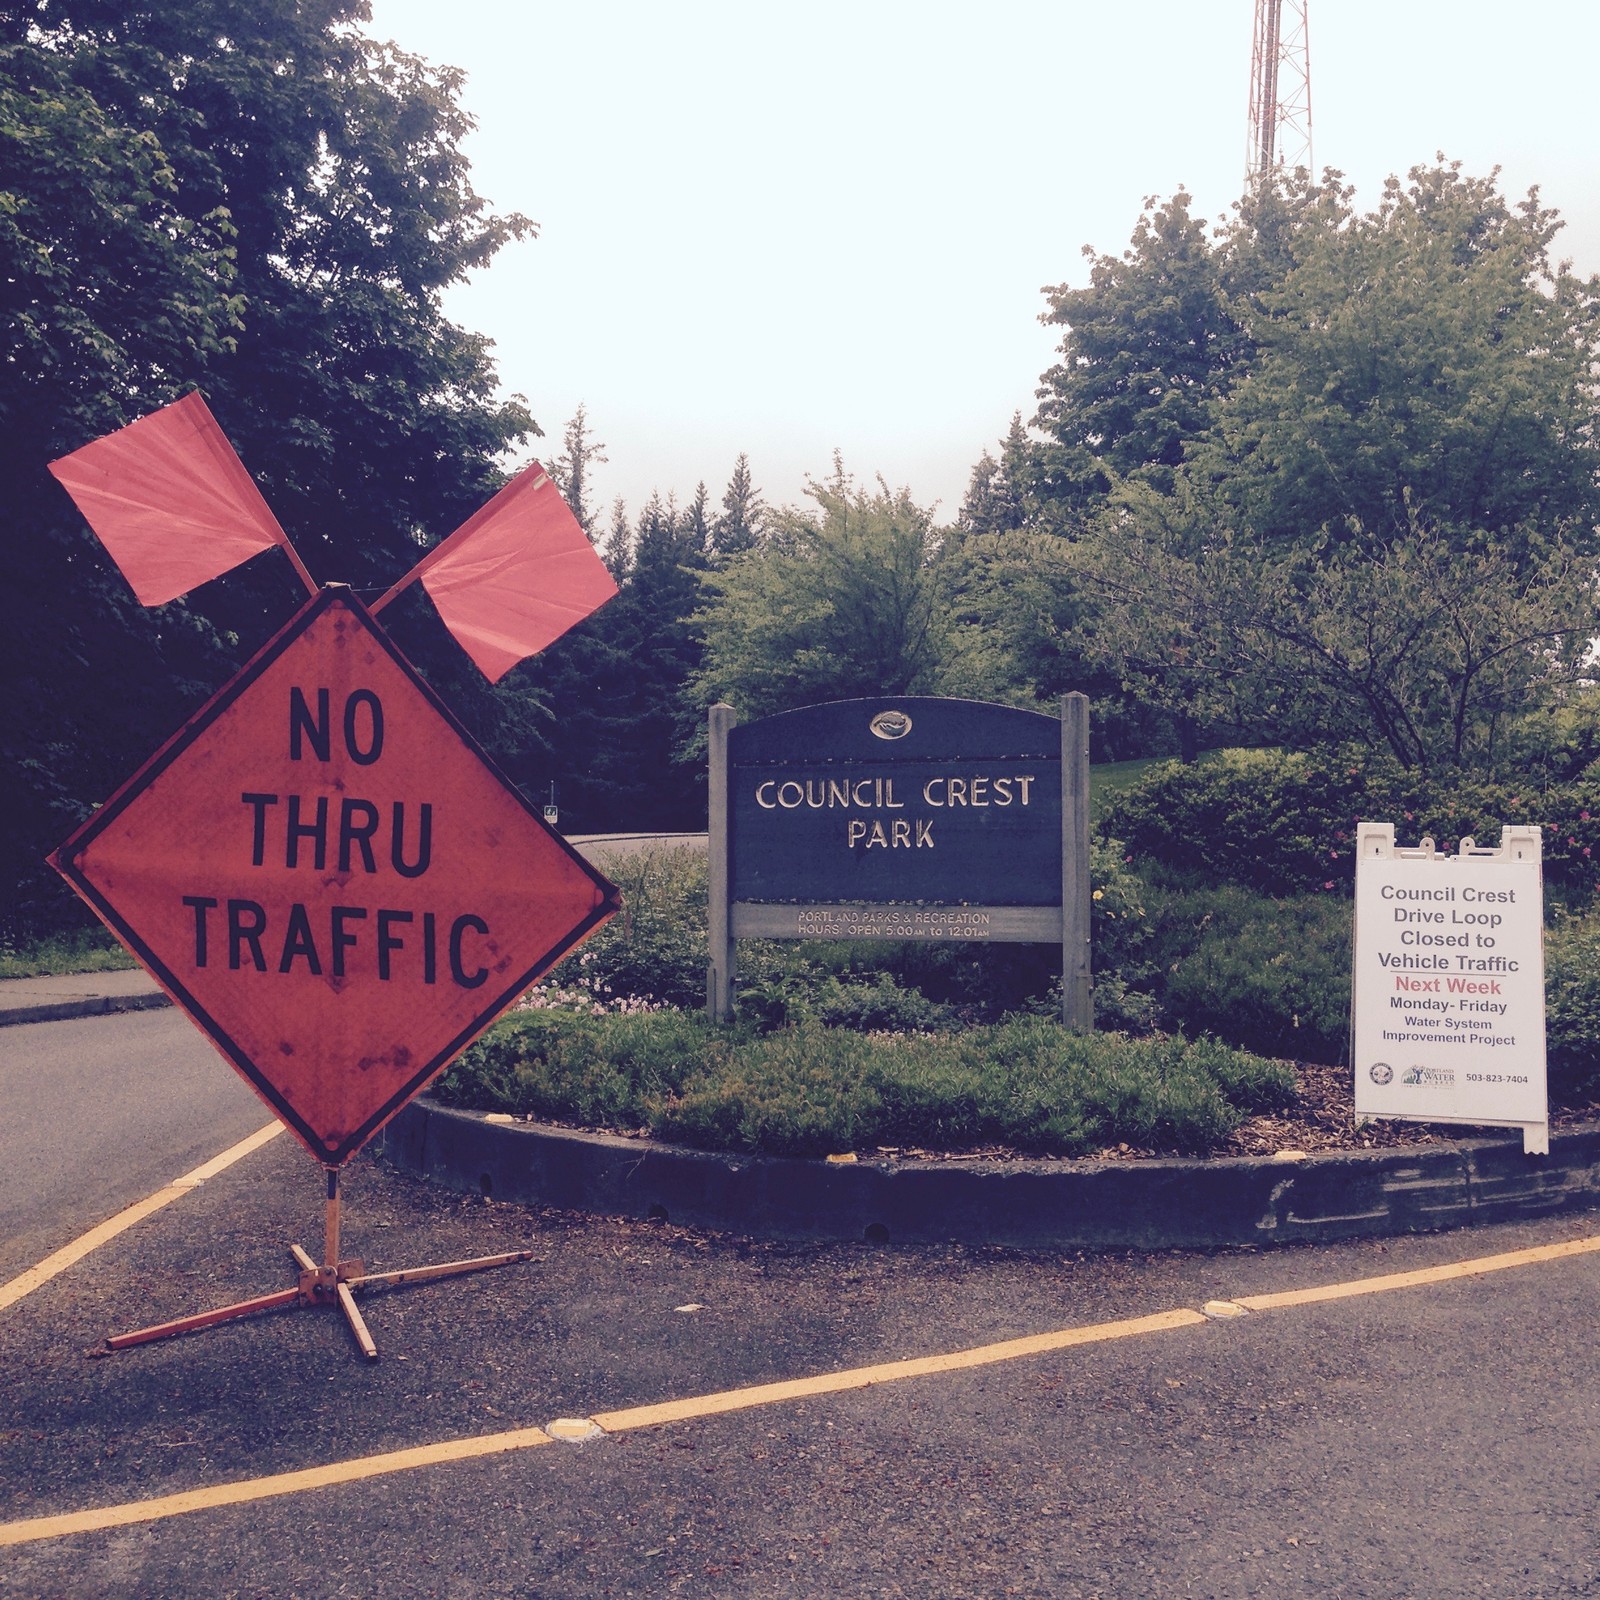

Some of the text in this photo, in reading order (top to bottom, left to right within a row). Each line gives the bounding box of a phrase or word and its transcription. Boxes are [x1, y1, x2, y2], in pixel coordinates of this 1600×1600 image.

[289, 686, 385, 766] NO
[755, 775, 1035, 809] COUNCIL CREST
[241, 792, 433, 878] THRU
[848, 819, 934, 848] PARK
[1381, 885, 1516, 903] Council Crest
[798, 912, 990, 924] PORTLAND PARKS & RECREATION
[1394, 908, 1502, 928] Drive Loop
[798, 924, 843, 934] HOURS:
[848, 925, 881, 935] OPEN
[182, 896, 489, 990] TRAFFIC
[1400, 930, 1496, 948] Closed to
[1378, 952, 1519, 972] Vehicle Traffic
[1395, 976, 1501, 994] Next Week
[1390, 997, 1507, 1015] Monday- Friday
[1405, 1016, 1492, 1030] Water System
[1382, 1030, 1515, 1046] Improvement Project
[1423, 1072, 1455, 1082] WATER
[1466, 1073, 1528, 1083] 503-823-7404
